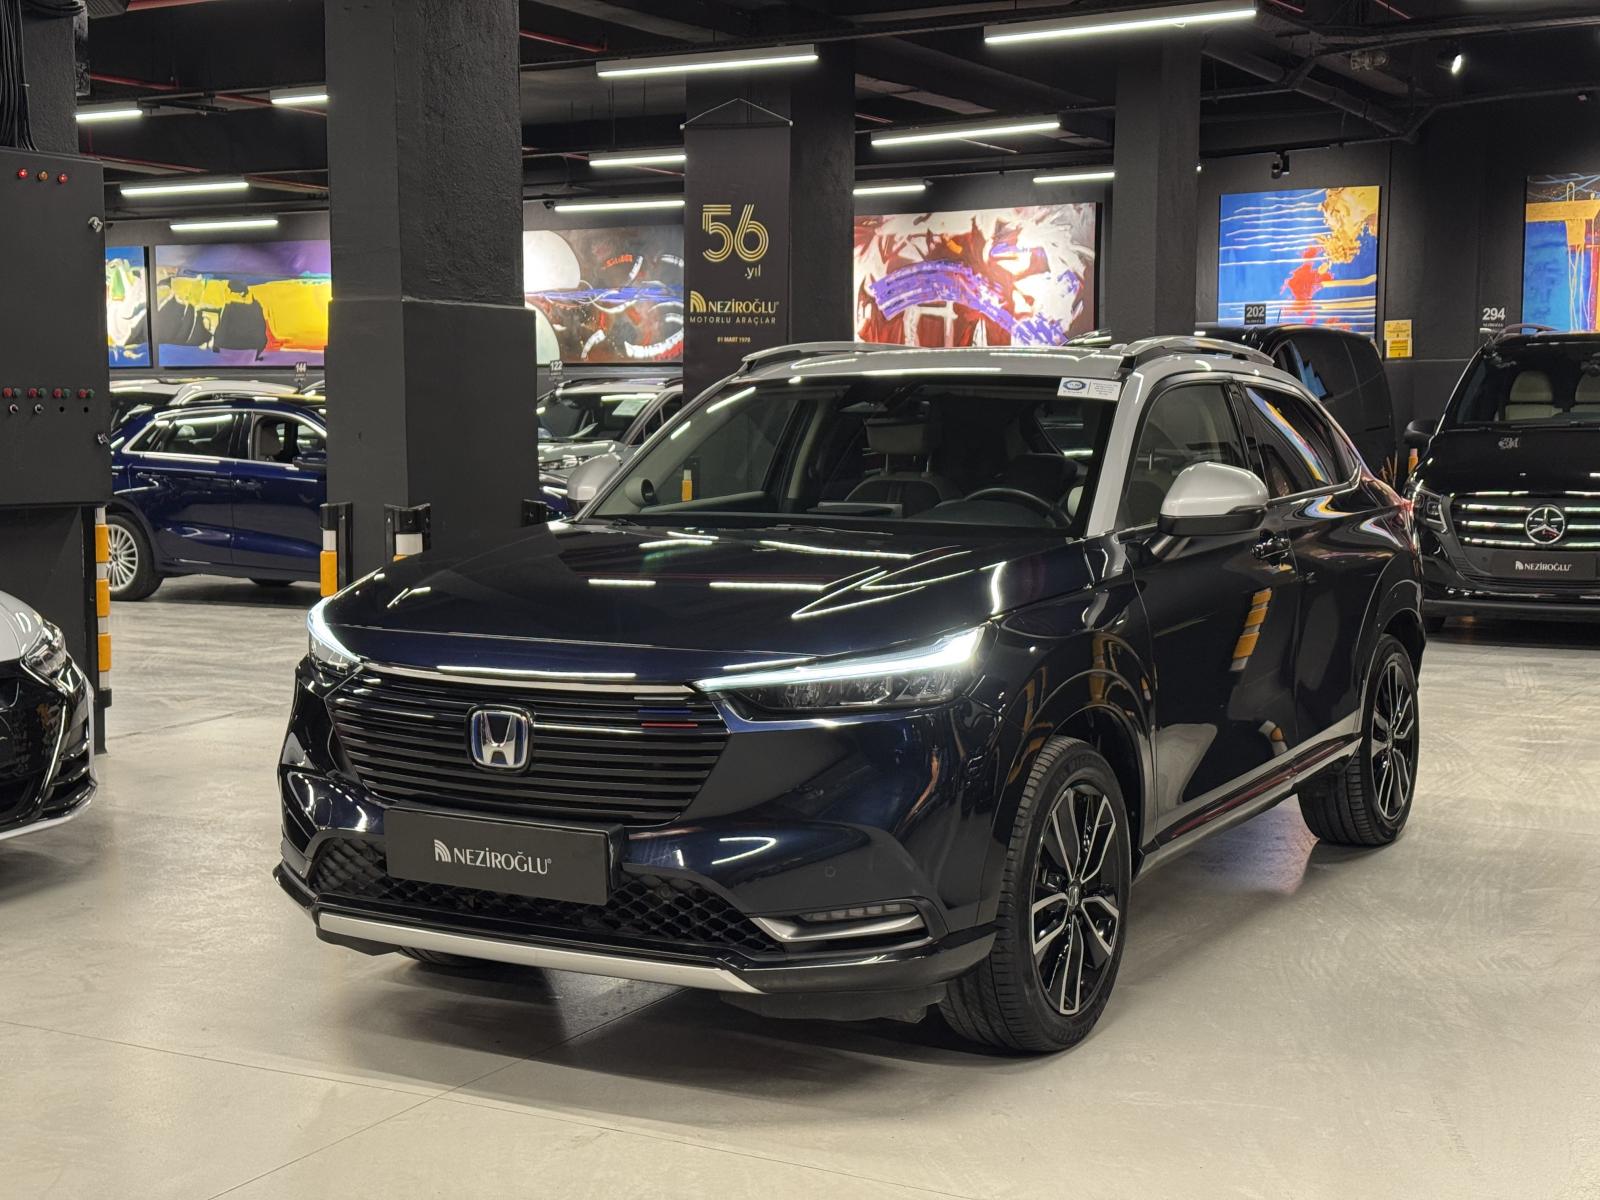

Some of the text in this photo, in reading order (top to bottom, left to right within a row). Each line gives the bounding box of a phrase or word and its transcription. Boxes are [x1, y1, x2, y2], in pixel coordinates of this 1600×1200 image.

[702, 204, 769, 262] 56
[1246, 306, 1264, 317] 202
[1482, 307, 1506, 320] 294
[689, 316, 776, 325] MOTORLU ARAÇLAR
[550, 360, 563, 371] 122
[453, 847, 548, 874] NEZİROĞLU
